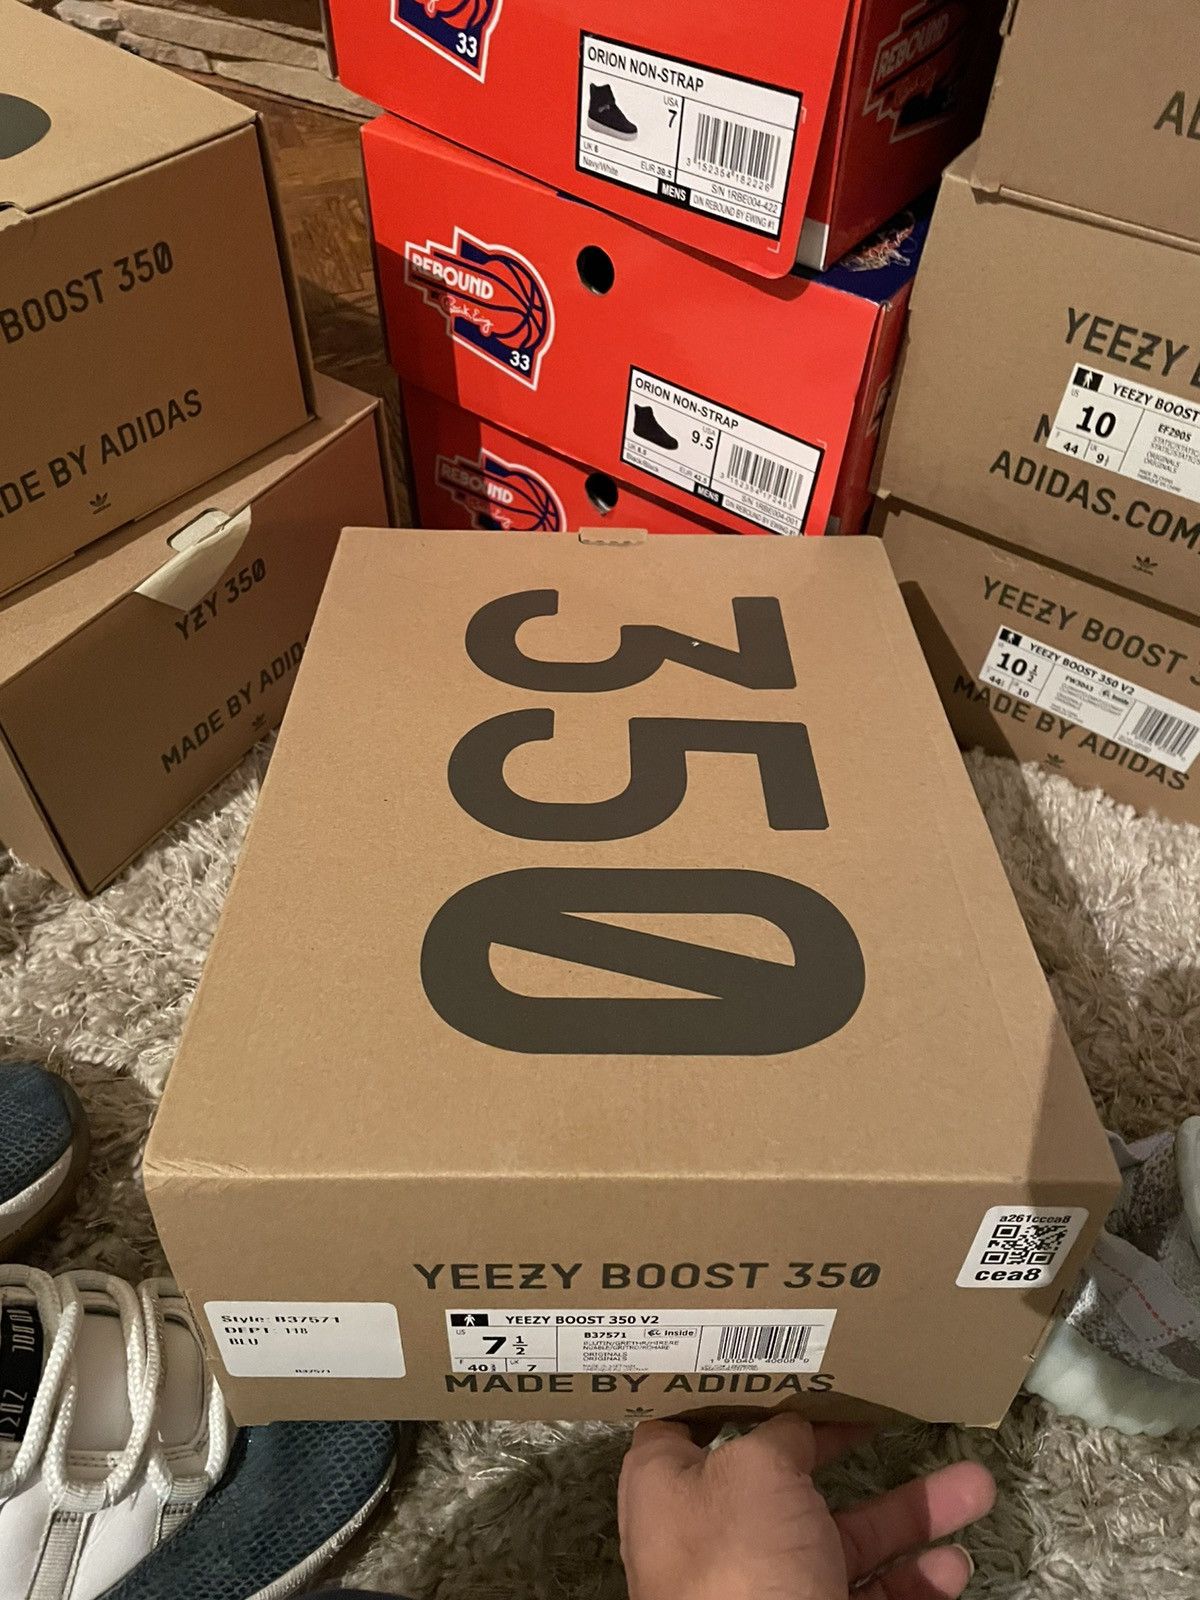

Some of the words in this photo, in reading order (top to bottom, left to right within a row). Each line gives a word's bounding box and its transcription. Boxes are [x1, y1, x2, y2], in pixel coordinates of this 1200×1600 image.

[456, 32, 478, 58] 33
[587, 46, 627, 71] ORION
[630, 58, 704, 92] NON-STRAP
[663, 94, 679, 108] USA
[667, 109, 678, 129] 7
[661, 182, 687, 201] MENS
[705, 199, 735, 217] REBOUND
[735, 208, 744, 219] BY
[745, 212, 766, 228] EWING
[411, 252, 494, 300] REBOUND
[0, 268, 105, 344] BOOST
[113, 240, 175, 293] 350
[1065, 307, 1190, 377] YEEZY
[509, 350, 531, 371] 33
[635, 377, 671, 401] ORION
[673, 392, 739, 431] NON-STRAP
[1112, 382, 1154, 406] YEEZY
[1155, 397, 1200, 422] BOOST
[1076, 405, 1117, 438] 10
[48, 444, 87, 489] BY
[100, 388, 203, 465] ADIDAS
[691, 430, 714, 450] 9.5
[1158, 423, 1192, 442] EF2905
[1063, 441, 1078, 455] 44
[697, 485, 720, 502] MENS
[174, 592, 219, 641] YZY
[224, 558, 267, 603] 350
[982, 575, 1078, 630] YEEZY
[1081, 617, 1189, 674] BOOST
[997, 652, 1028, 676] 10
[1029, 642, 1062, 662] YEEZY
[1062, 656, 1098, 679] BOOST
[1098, 674, 1119, 688] 350
[1121, 683, 1135, 696] V2
[1018, 688, 1029, 698] 10
[160, 709, 225, 774] MADE
[226, 682, 252, 719] BY
[952, 675, 1031, 723] MADE
[1035, 713, 1077, 740] BY
[1078, 732, 1190, 791] ADIDAS
[419, 588, 866, 1056] 350
[999, 1214, 1072, 1224] a261ccea8
[412, 1262, 583, 1290] YEEZY
[601, 1262, 769, 1290] BOOST
[783, 1261, 881, 1290] 350
[975, 1268, 1042, 1281] cea8
[274, 1315, 340, 1324] B37571
[505, 1315, 550, 1325] YEEZY
[555, 1315, 605, 1325] BOOST
[608, 1315, 636, 1325] 350
[640, 1315, 660, 1325] V2
[229, 1338, 259, 1346] BLU
[482, 1336, 507, 1355] 7
[584, 1331, 627, 1339] B37571
[467, 1364, 489, 1372] 40
[527, 1364, 537, 1372] 7
[445, 1374, 574, 1393] MADE
[592, 1374, 650, 1393] BY
[663, 1373, 836, 1393] ADIDAS
